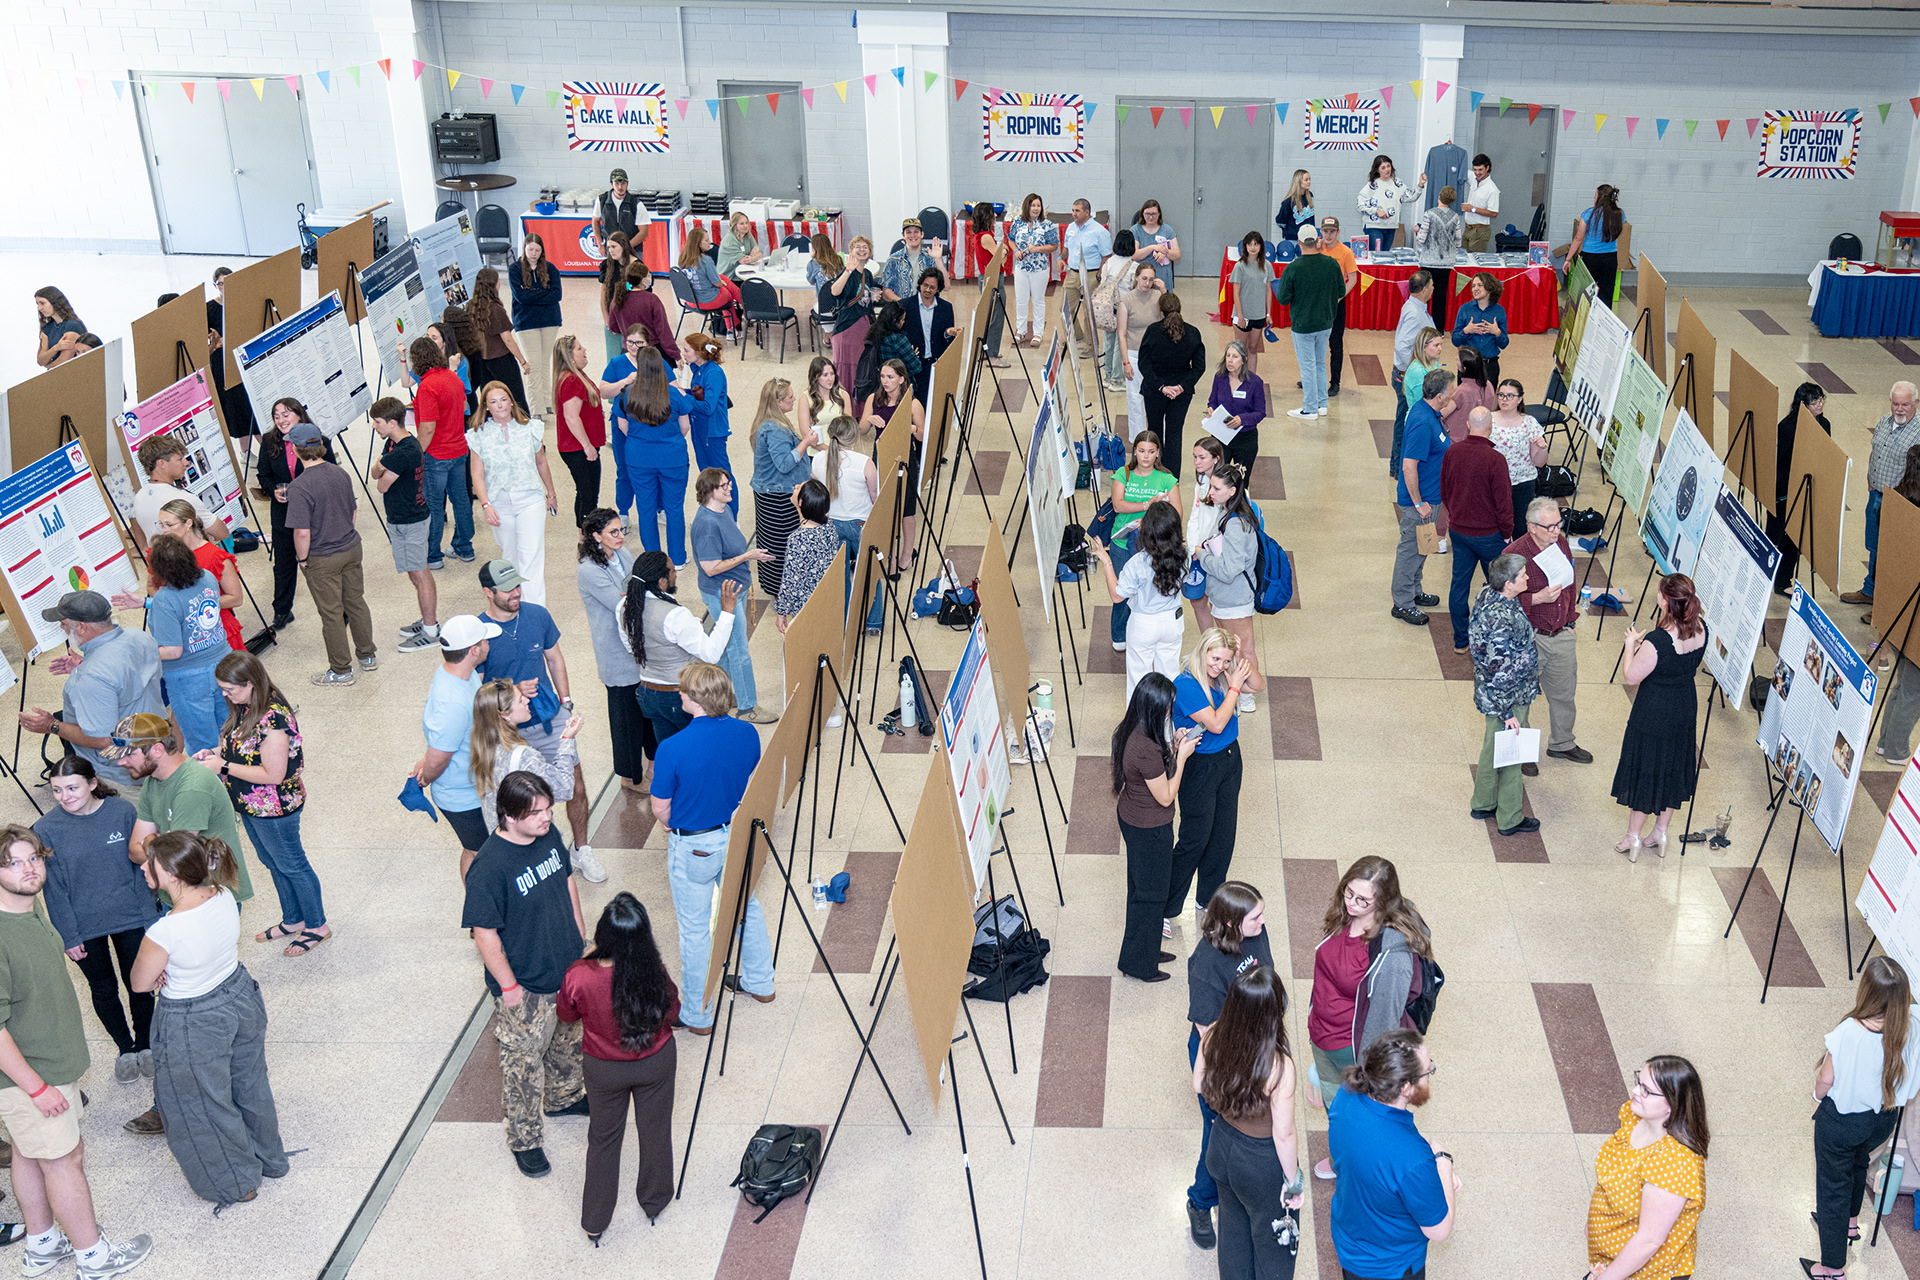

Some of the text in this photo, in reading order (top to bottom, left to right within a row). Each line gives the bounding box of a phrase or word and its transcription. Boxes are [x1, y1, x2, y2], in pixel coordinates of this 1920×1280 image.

[580, 109, 613, 124] CAKE
[1007, 116, 1060, 135] ROPING
[1316, 116, 1368, 134] MERCH
[1780, 128, 1843, 145] POPCORN
[1780, 146, 1838, 162] STATION
[515, 848, 563, 896] got wood?
[1236, 954, 1254, 973] TEAM
